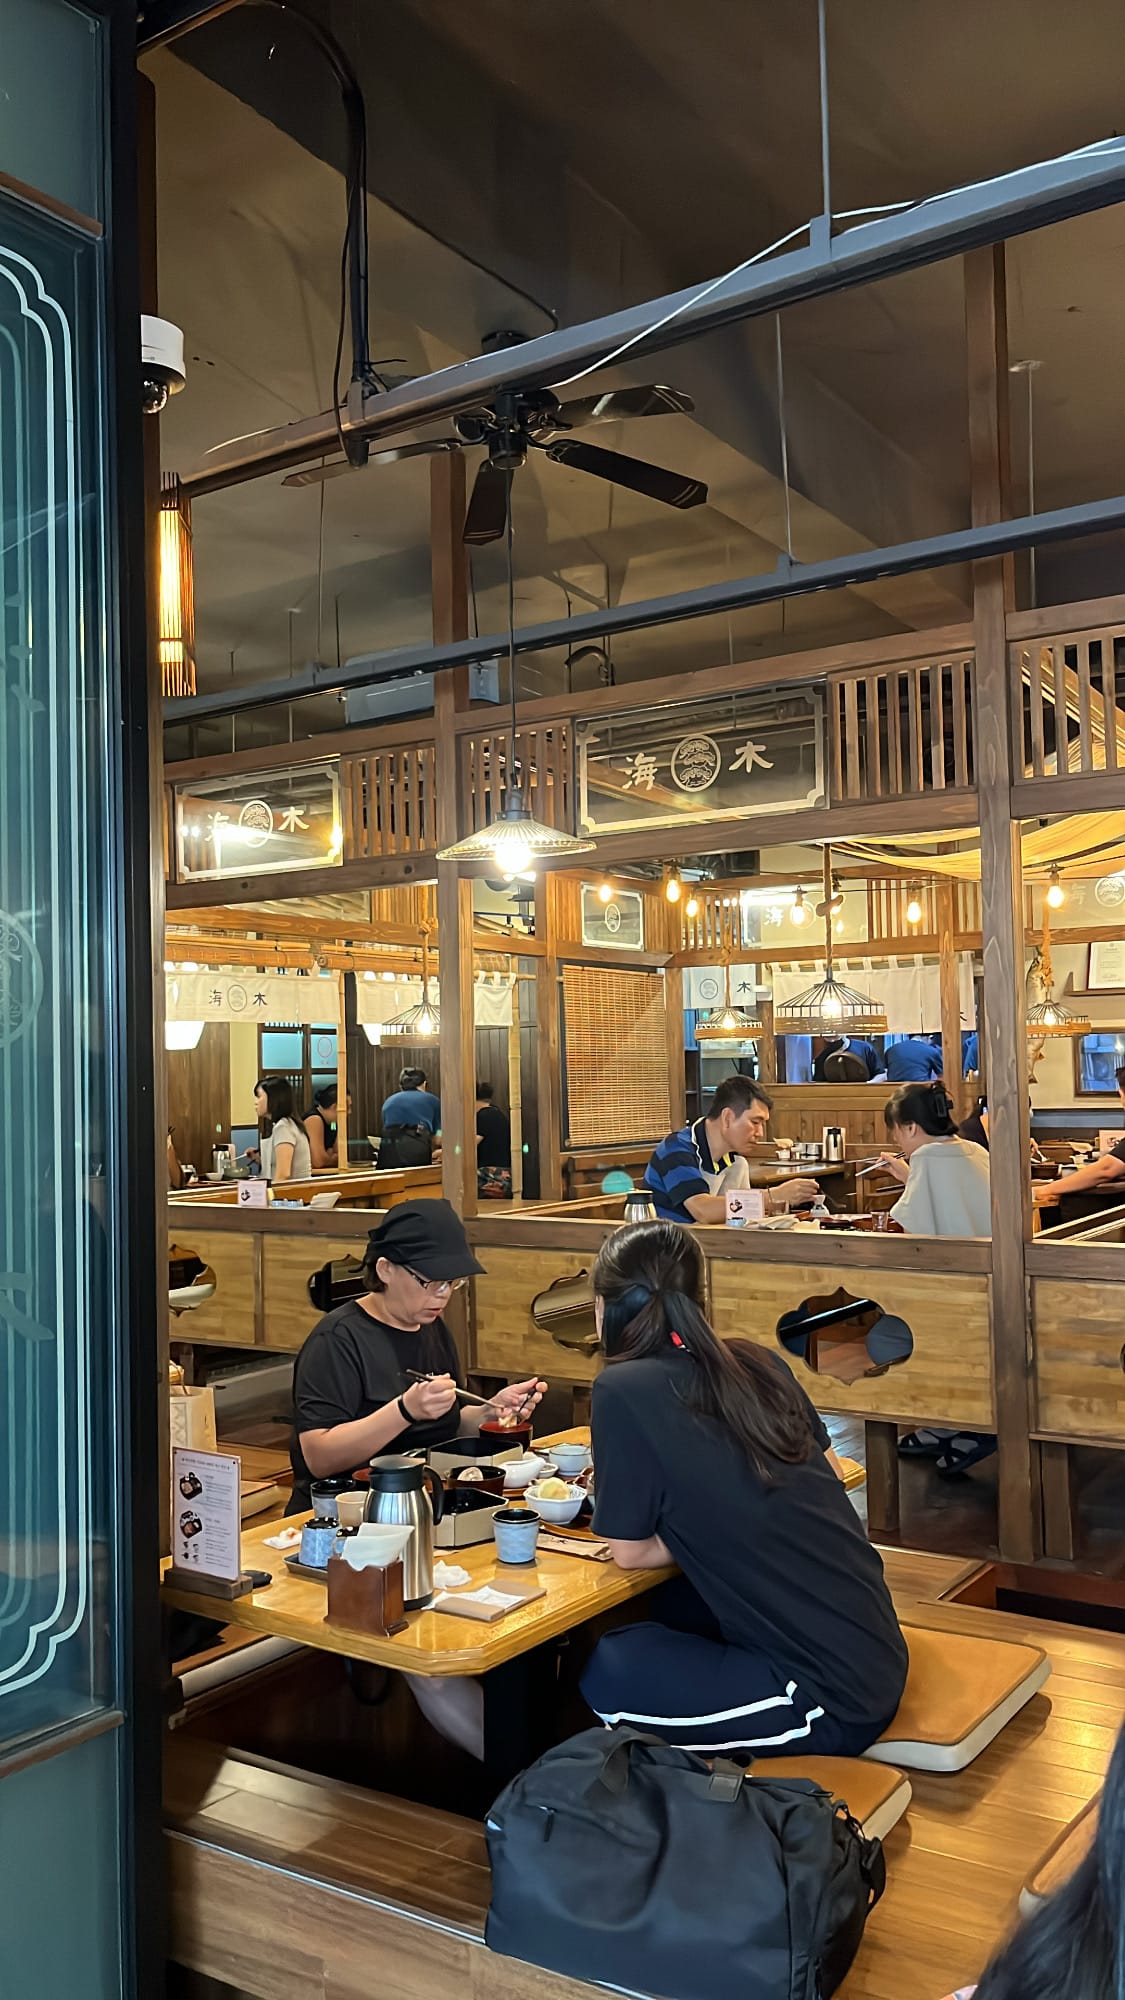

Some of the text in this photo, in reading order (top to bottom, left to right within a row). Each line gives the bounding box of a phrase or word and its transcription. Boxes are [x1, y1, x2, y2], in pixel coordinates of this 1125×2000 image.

[622, 740, 774, 791] 海 木
[278, 806, 310, 833] 木
[208, 989, 268, 1007] 海 木
[736, 981, 751, 994] 木
